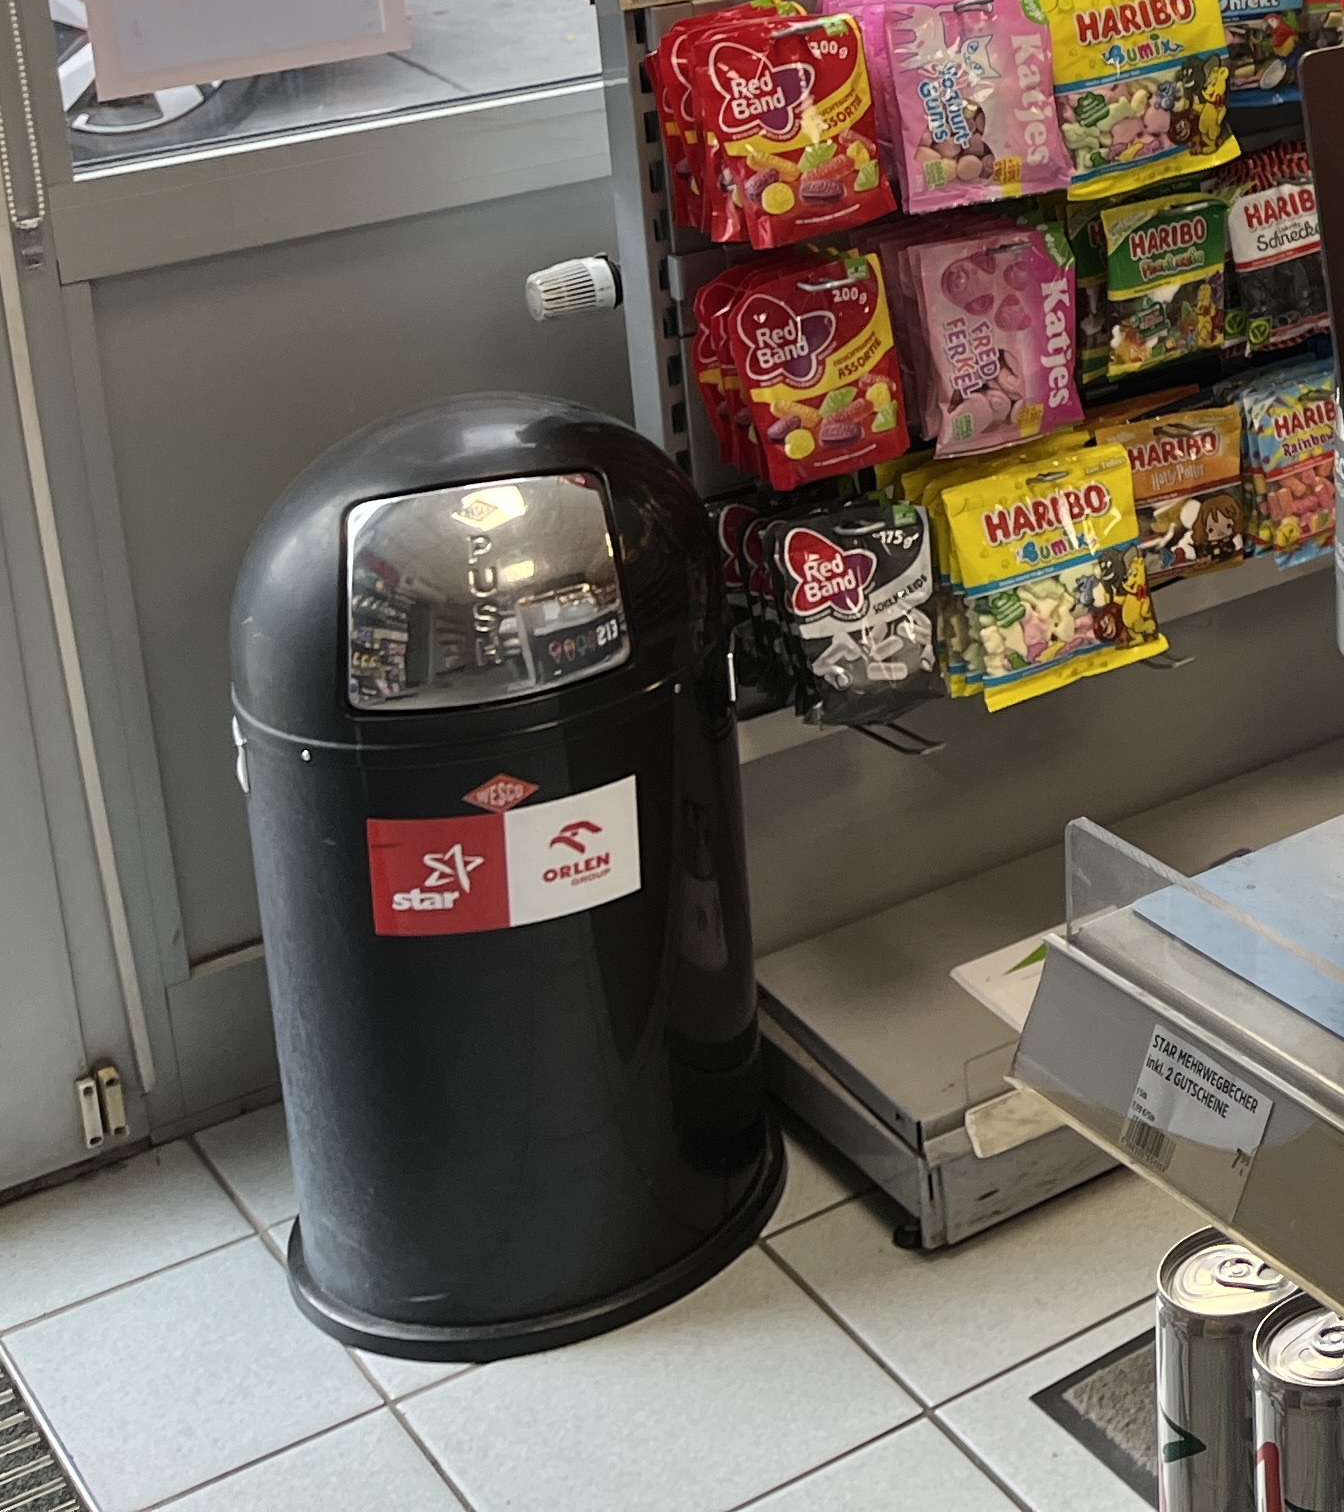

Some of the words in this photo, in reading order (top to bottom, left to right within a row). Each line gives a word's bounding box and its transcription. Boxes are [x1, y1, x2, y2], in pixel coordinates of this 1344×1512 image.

[731, 72, 773, 98] Red
[731, 91, 787, 121] Band
[1010, 33, 1051, 168] Katjes
[917, 78, 949, 144] Gums
[1129, 216, 1207, 261] HARIBO
[755, 320, 798, 349] Red
[756, 340, 809, 370] Band
[970, 319, 1000, 381] FRED
[1040, 276, 1072, 410] Katjes
[943, 315, 983, 399] FERKEL
[1127, 431, 1219, 473] HARIBO
[983, 480, 1111, 545] HARIBO
[802, 555, 844, 580] Red
[804, 573, 857, 602] Band
[543, 851, 611, 885] ORLEN
[391, 888, 461, 913] star
[1146, 1054, 1164, 1077] inkl.
[1165, 1067, 1174, 1082] 2
[1173, 1072, 1230, 1119] GUTSCHEINE
[1152, 1034, 1179, 1059] STAR
[1177, 1050, 1259, 1115] MEHRWEGBECHER
